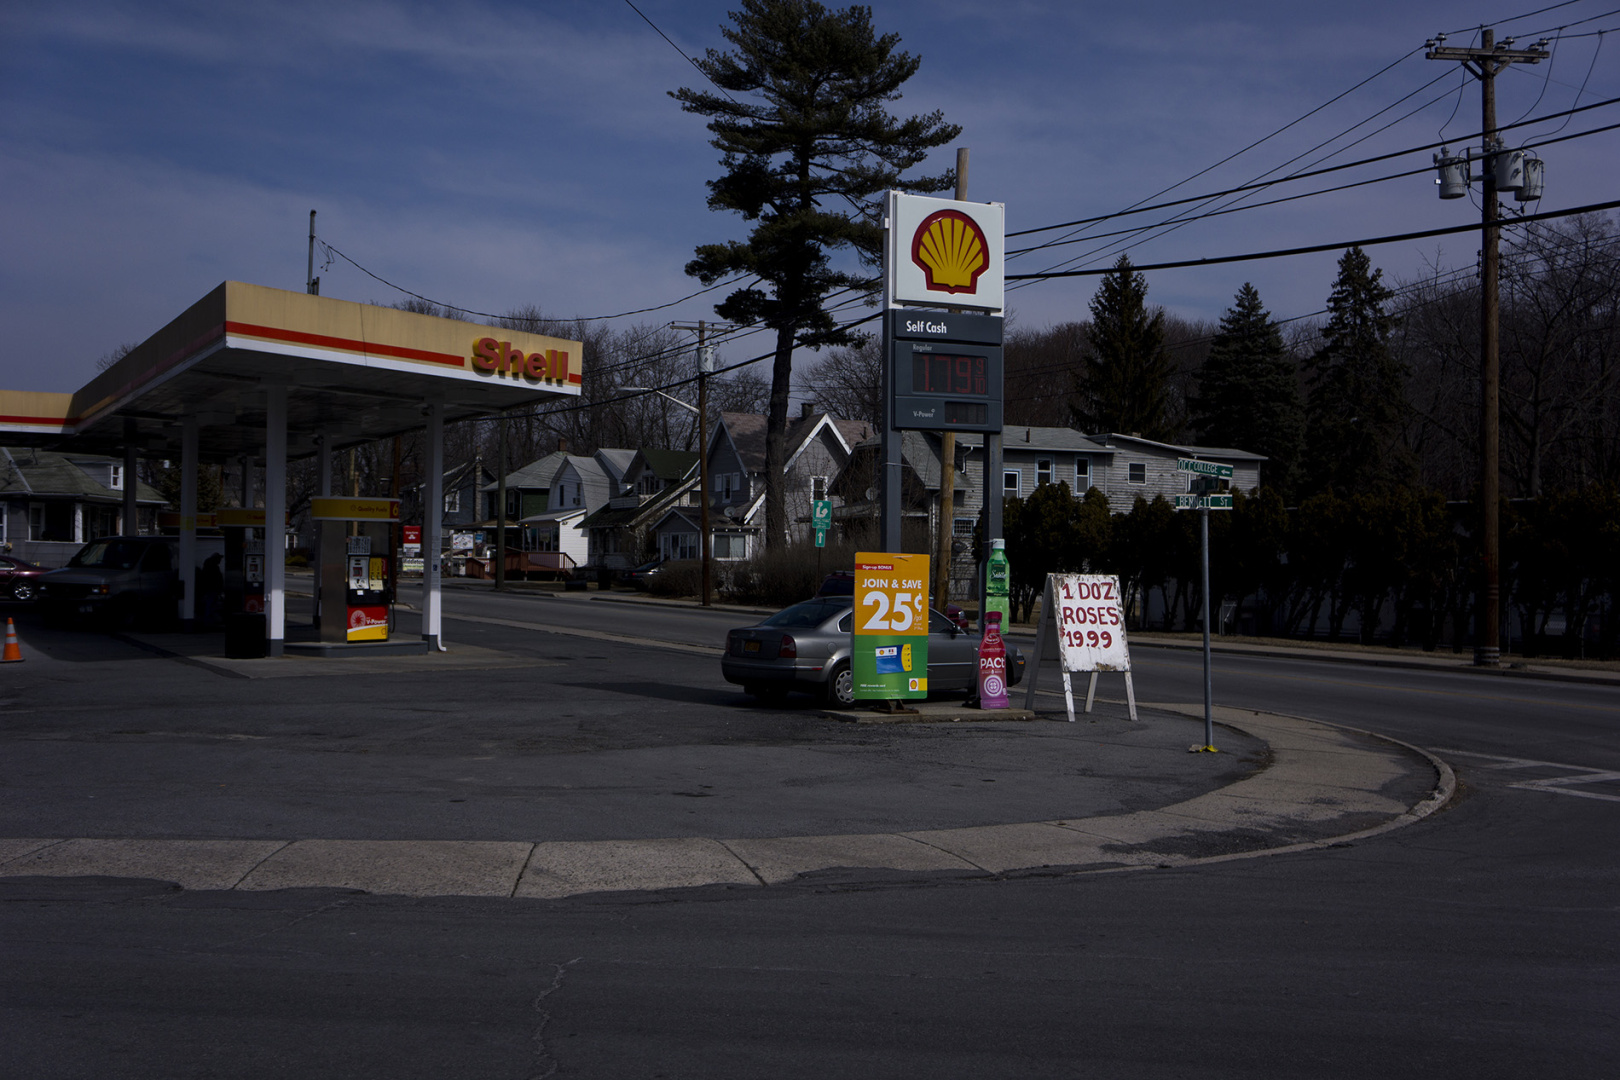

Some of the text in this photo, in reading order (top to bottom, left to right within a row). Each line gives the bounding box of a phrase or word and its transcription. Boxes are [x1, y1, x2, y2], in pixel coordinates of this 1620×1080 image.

[906, 320, 947, 334] Self Cash
[912, 343, 932, 352] Regular
[471, 337, 568, 380] Shell
[912, 408, 934, 418] V-Power
[1178, 459, 1218, 474] OCC COLLEGE
[1180, 496, 1212, 508] BENNETT
[392, 503, 399, 516] 6
[862, 578, 922, 590] JOIN & SAVE
[1062, 582, 1118, 600] 1 DOZ.
[1062, 606, 1119, 626] ROSES
[1060, 626, 1113, 649] $19.99
